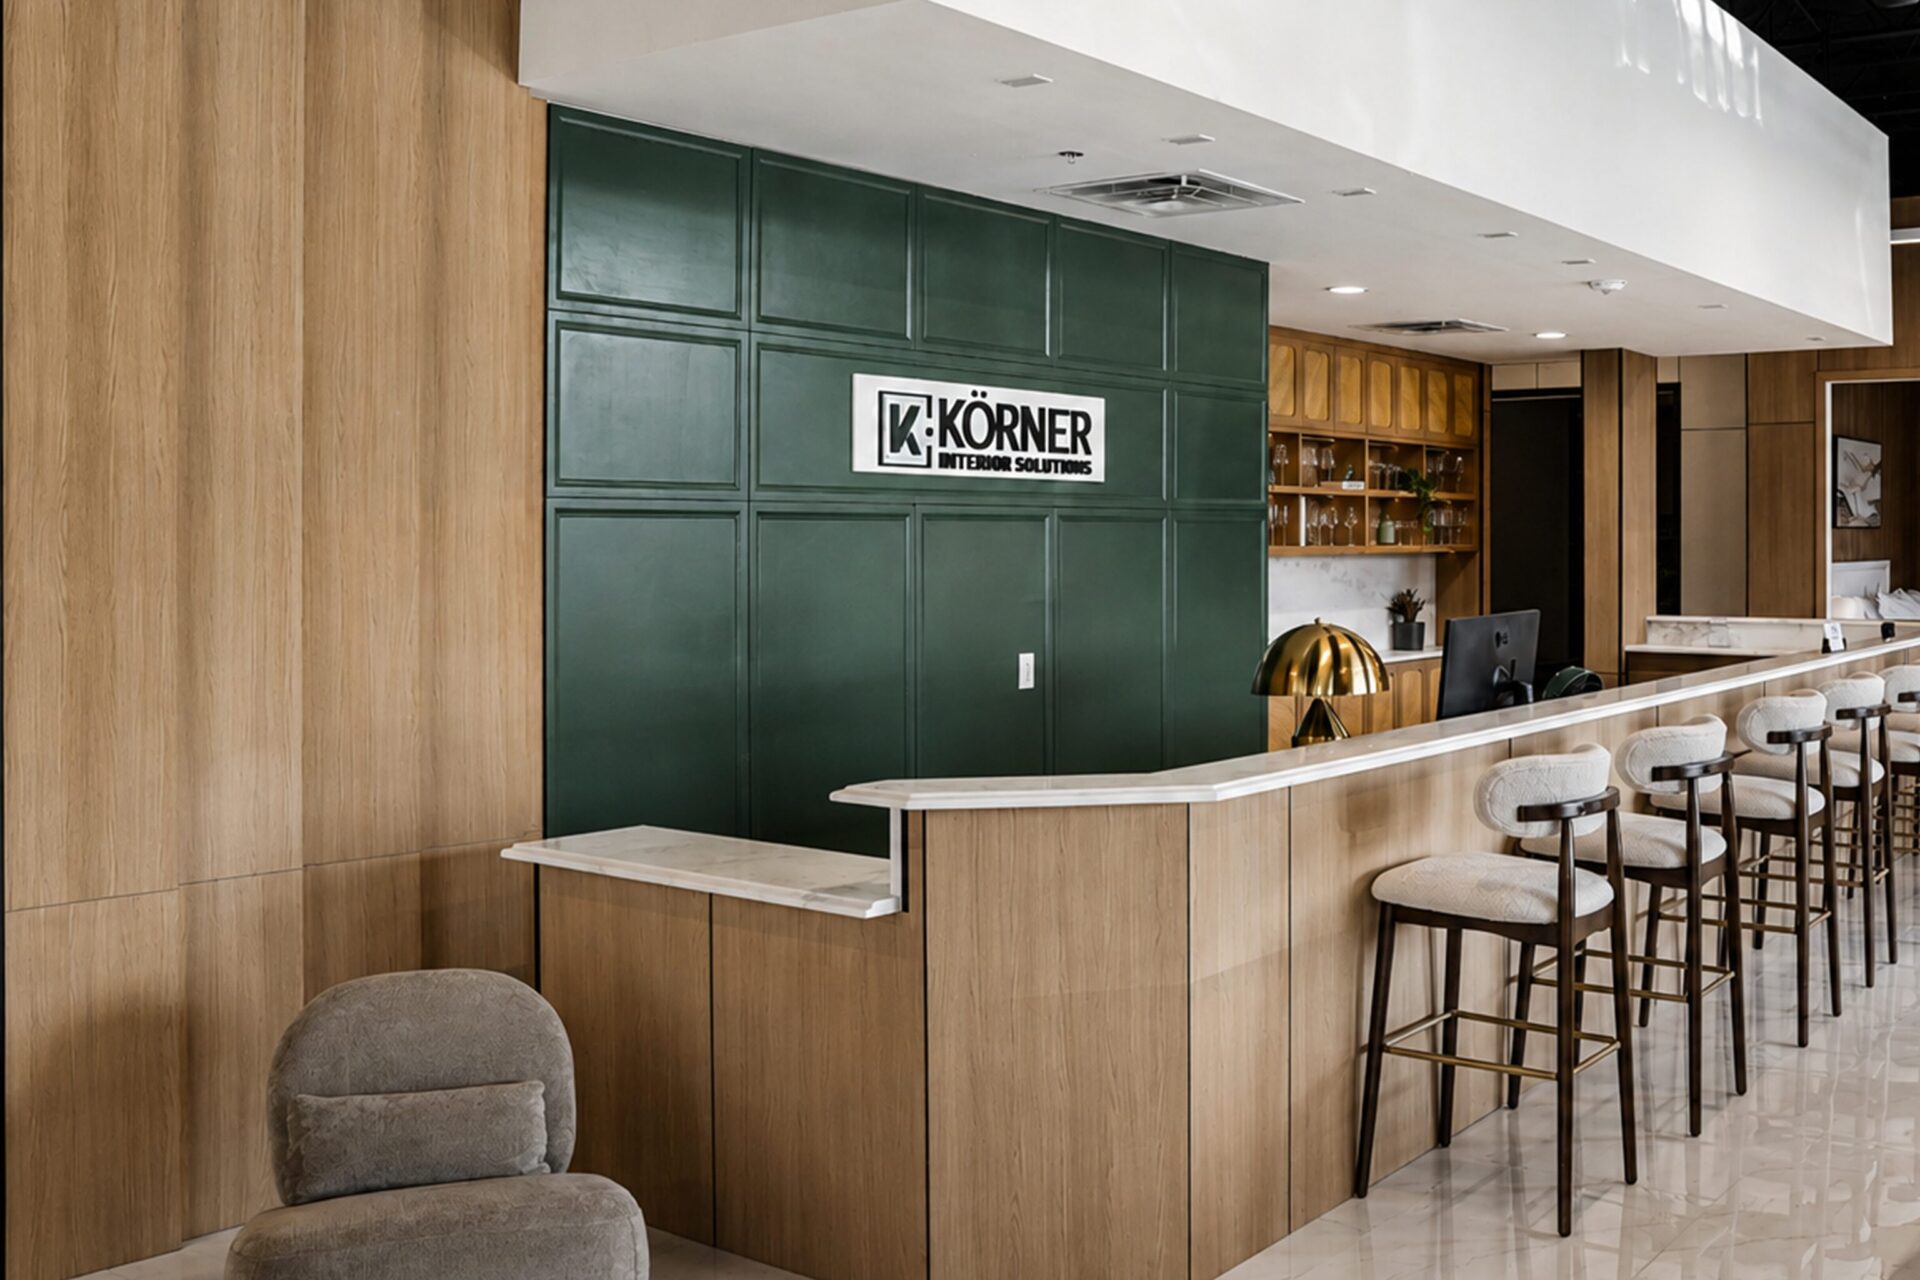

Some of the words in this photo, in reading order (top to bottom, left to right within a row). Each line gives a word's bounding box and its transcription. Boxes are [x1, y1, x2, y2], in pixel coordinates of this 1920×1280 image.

[889, 403, 922, 456] K
[938, 390, 1092, 455] KÖRNER
[938, 452, 1012, 471] INTERIOR
[1015, 457, 1092, 475] SOLUTIONS
